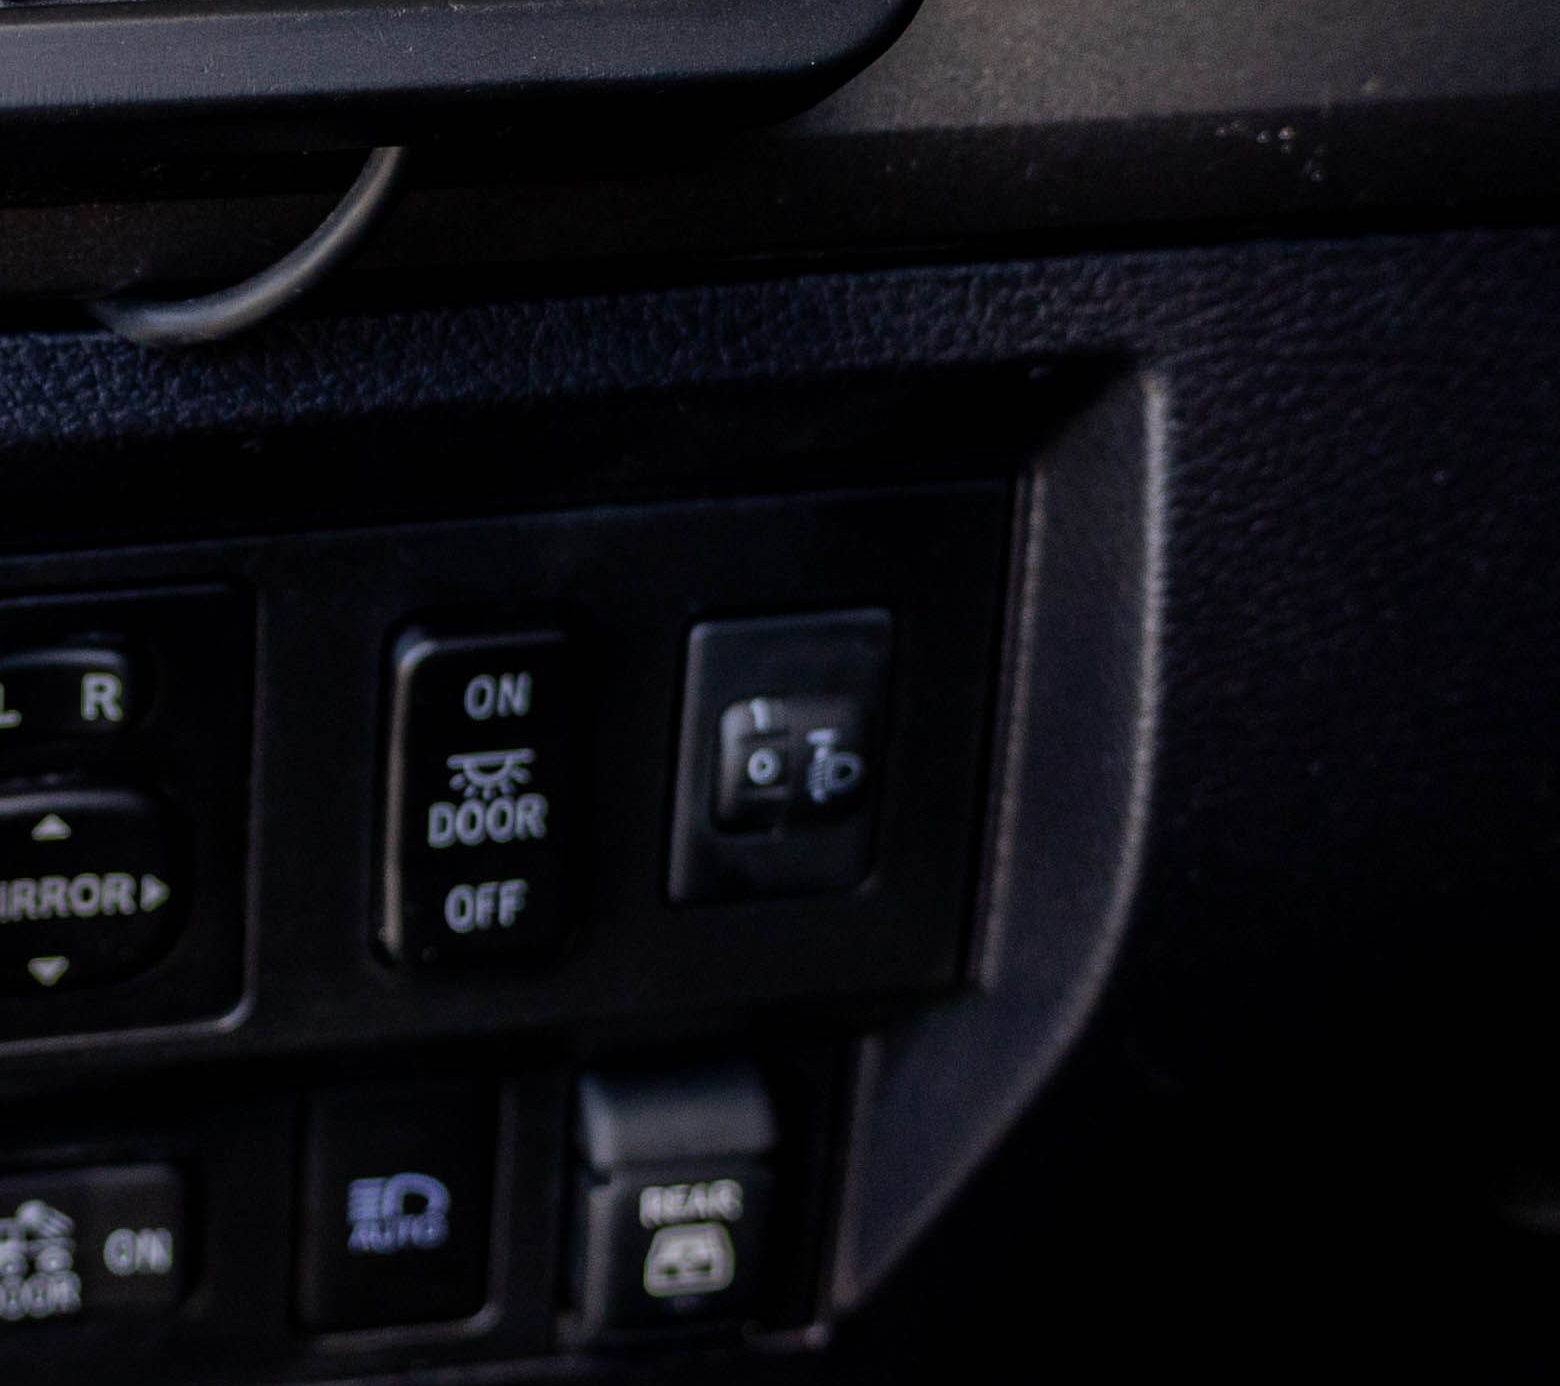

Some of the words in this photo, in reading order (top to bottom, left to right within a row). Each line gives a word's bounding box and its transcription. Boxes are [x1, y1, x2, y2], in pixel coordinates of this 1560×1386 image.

[80, 671, 124, 722] R
[463, 672, 533, 720] ON
[427, 794, 548, 849] DOOR
[444, 878, 528, 934] OFF
[639, 1178, 744, 1229] REAR
[102, 1226, 174, 1277] ON
